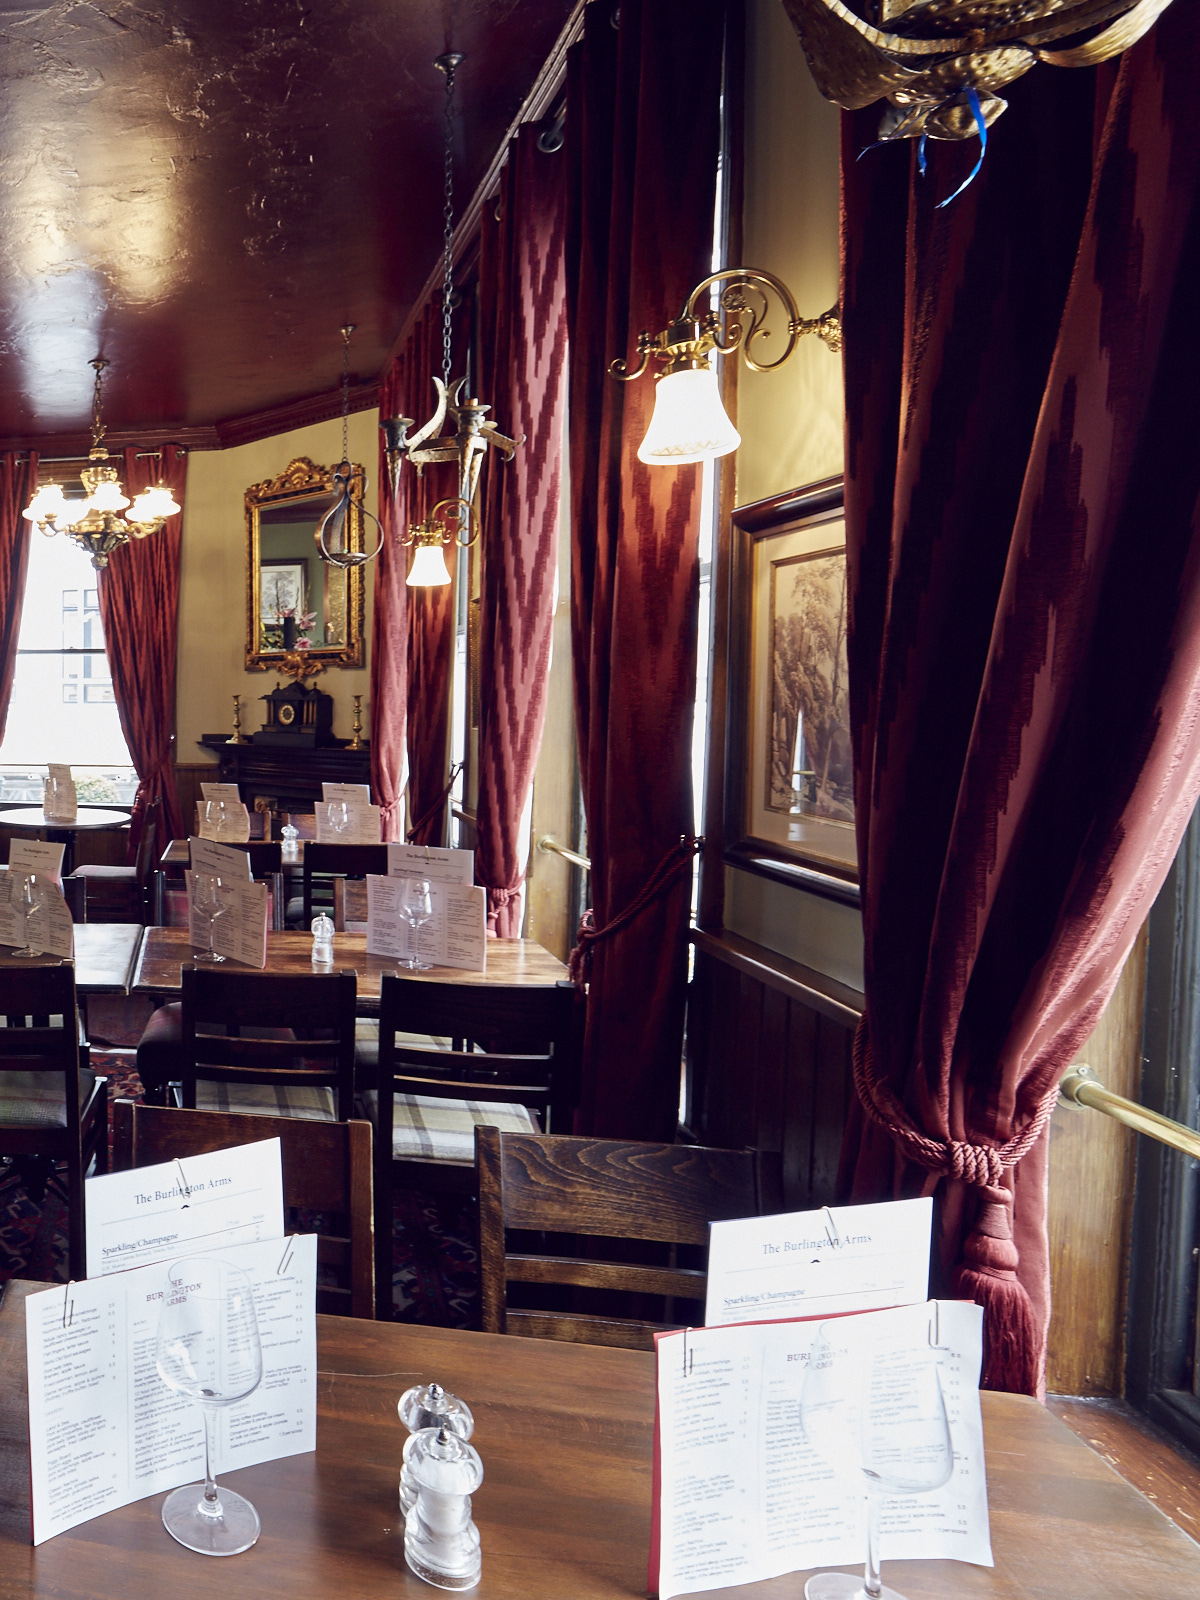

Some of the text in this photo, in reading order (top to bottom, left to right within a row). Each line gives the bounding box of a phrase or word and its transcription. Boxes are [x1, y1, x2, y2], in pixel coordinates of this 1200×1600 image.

[134, 1178, 232, 1205] The Burlington Arms
[762, 1234, 872, 1255] The Burlington Arms
